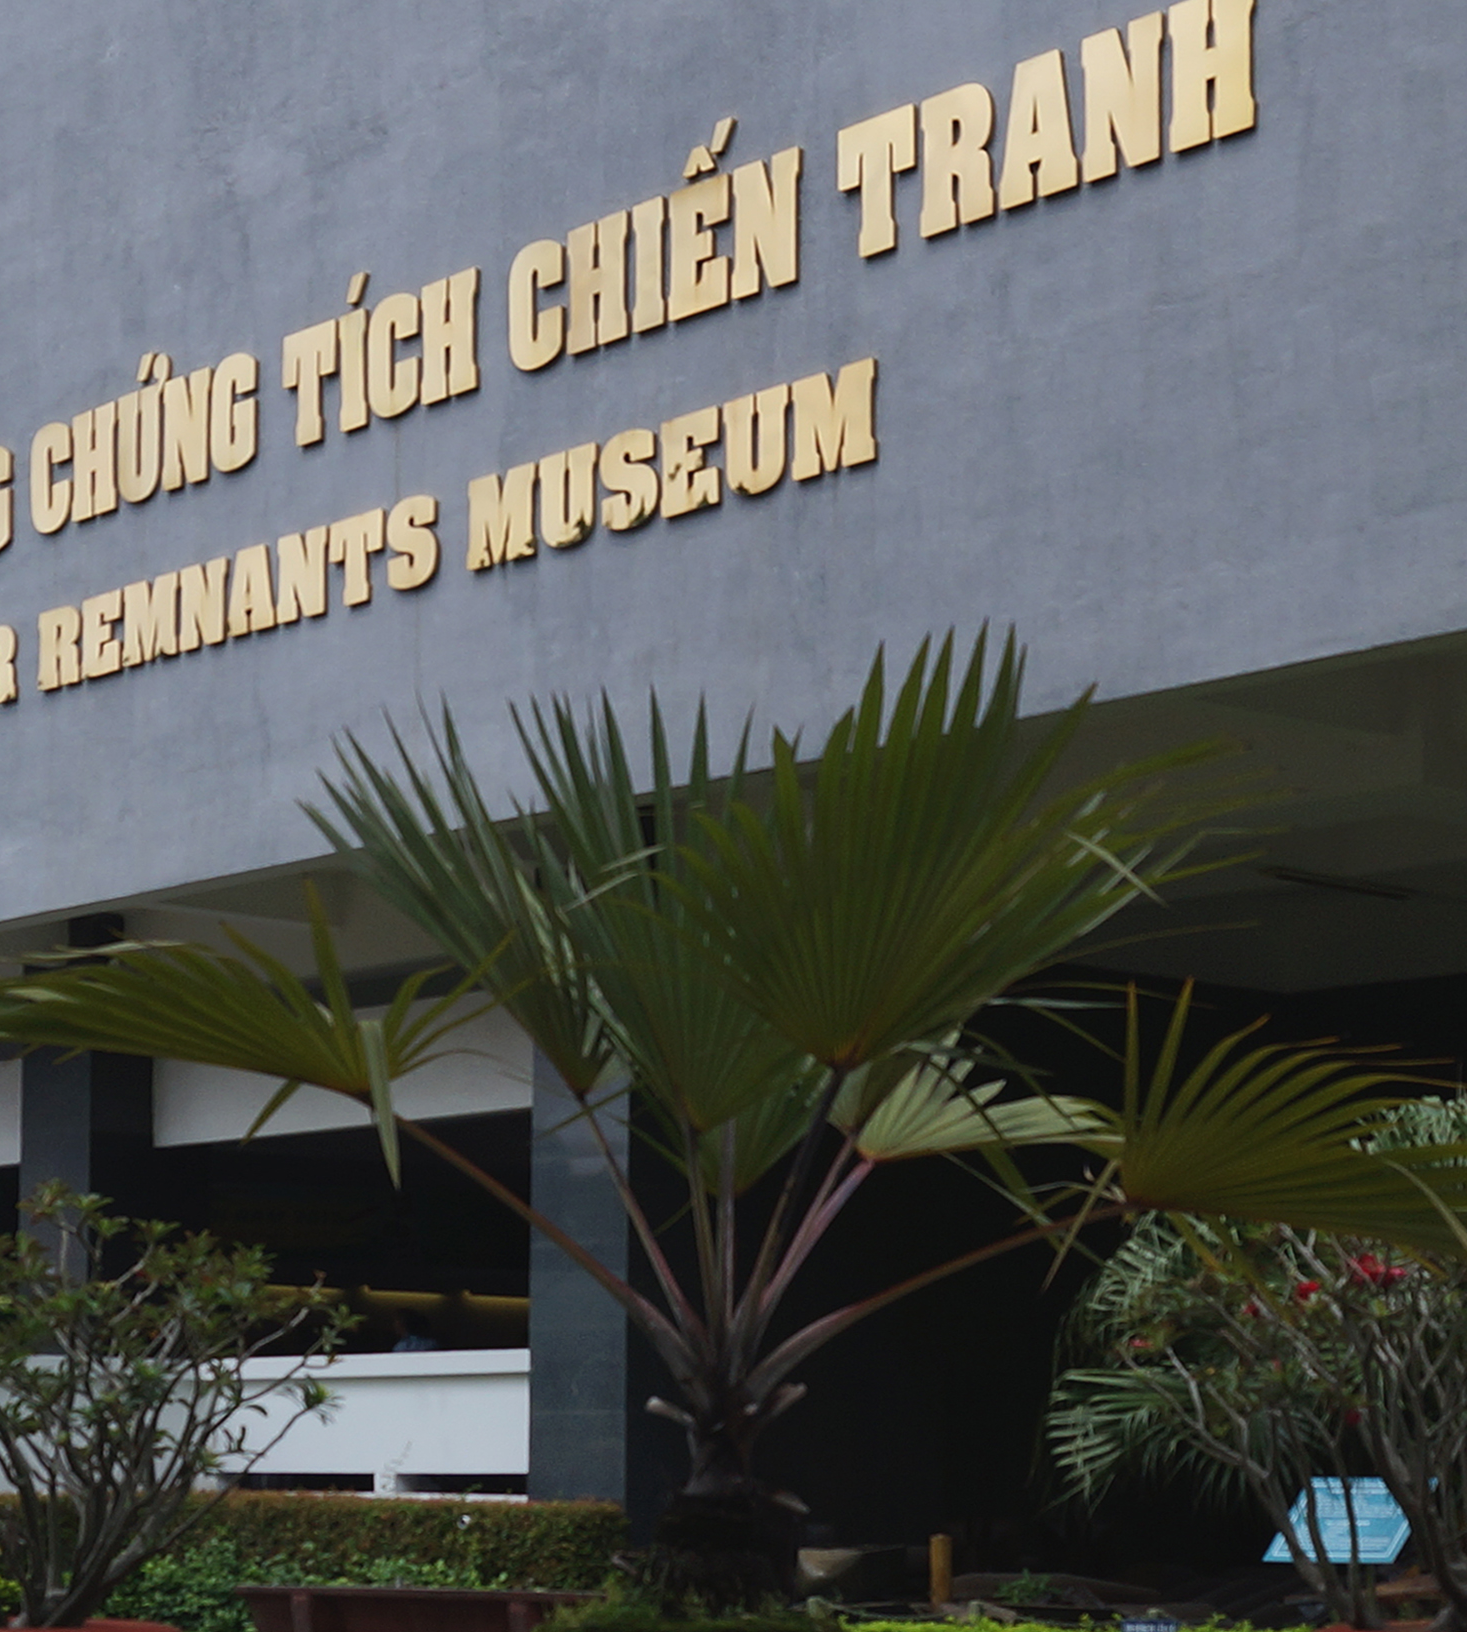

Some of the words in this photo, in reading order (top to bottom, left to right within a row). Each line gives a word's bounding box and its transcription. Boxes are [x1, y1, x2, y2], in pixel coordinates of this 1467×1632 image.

[31, 353, 259, 535] CHỨNG
[282, 267, 480, 447] TÍCH
[509, 118, 803, 372] CHIẾN
[38, 495, 441, 692] REMNANTS
[466, 357, 878, 571] MUSEUM
